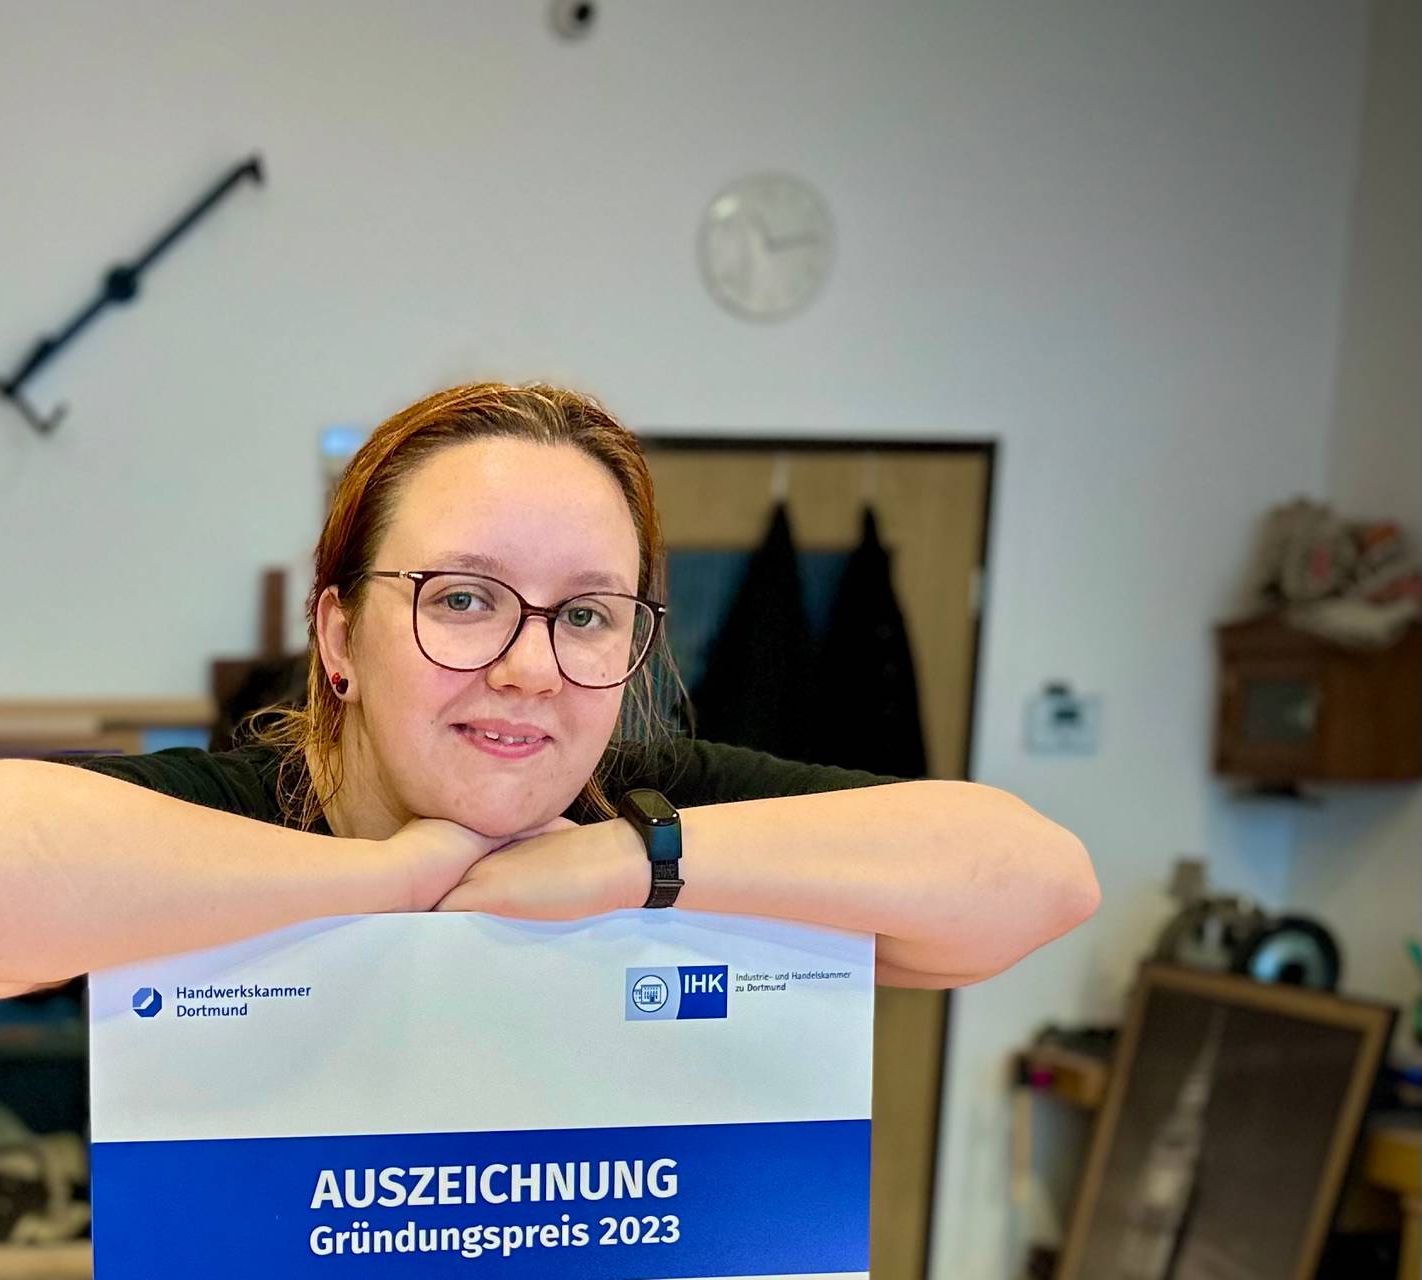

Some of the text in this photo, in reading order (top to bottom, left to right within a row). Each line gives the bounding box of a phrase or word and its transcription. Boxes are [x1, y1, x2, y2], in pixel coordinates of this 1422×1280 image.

[684, 973, 724, 994] IHK
[735, 971, 852, 982] Industrie- und Handelskammer
[176, 984, 312, 999] Handwerkskammer
[747, 982, 787, 992] Dortmund
[176, 1003, 248, 1018] Dortmund
[310, 1158, 678, 1209] AUSZEICHNUNG
[309, 1214, 681, 1259] Gründungspreis 2023
